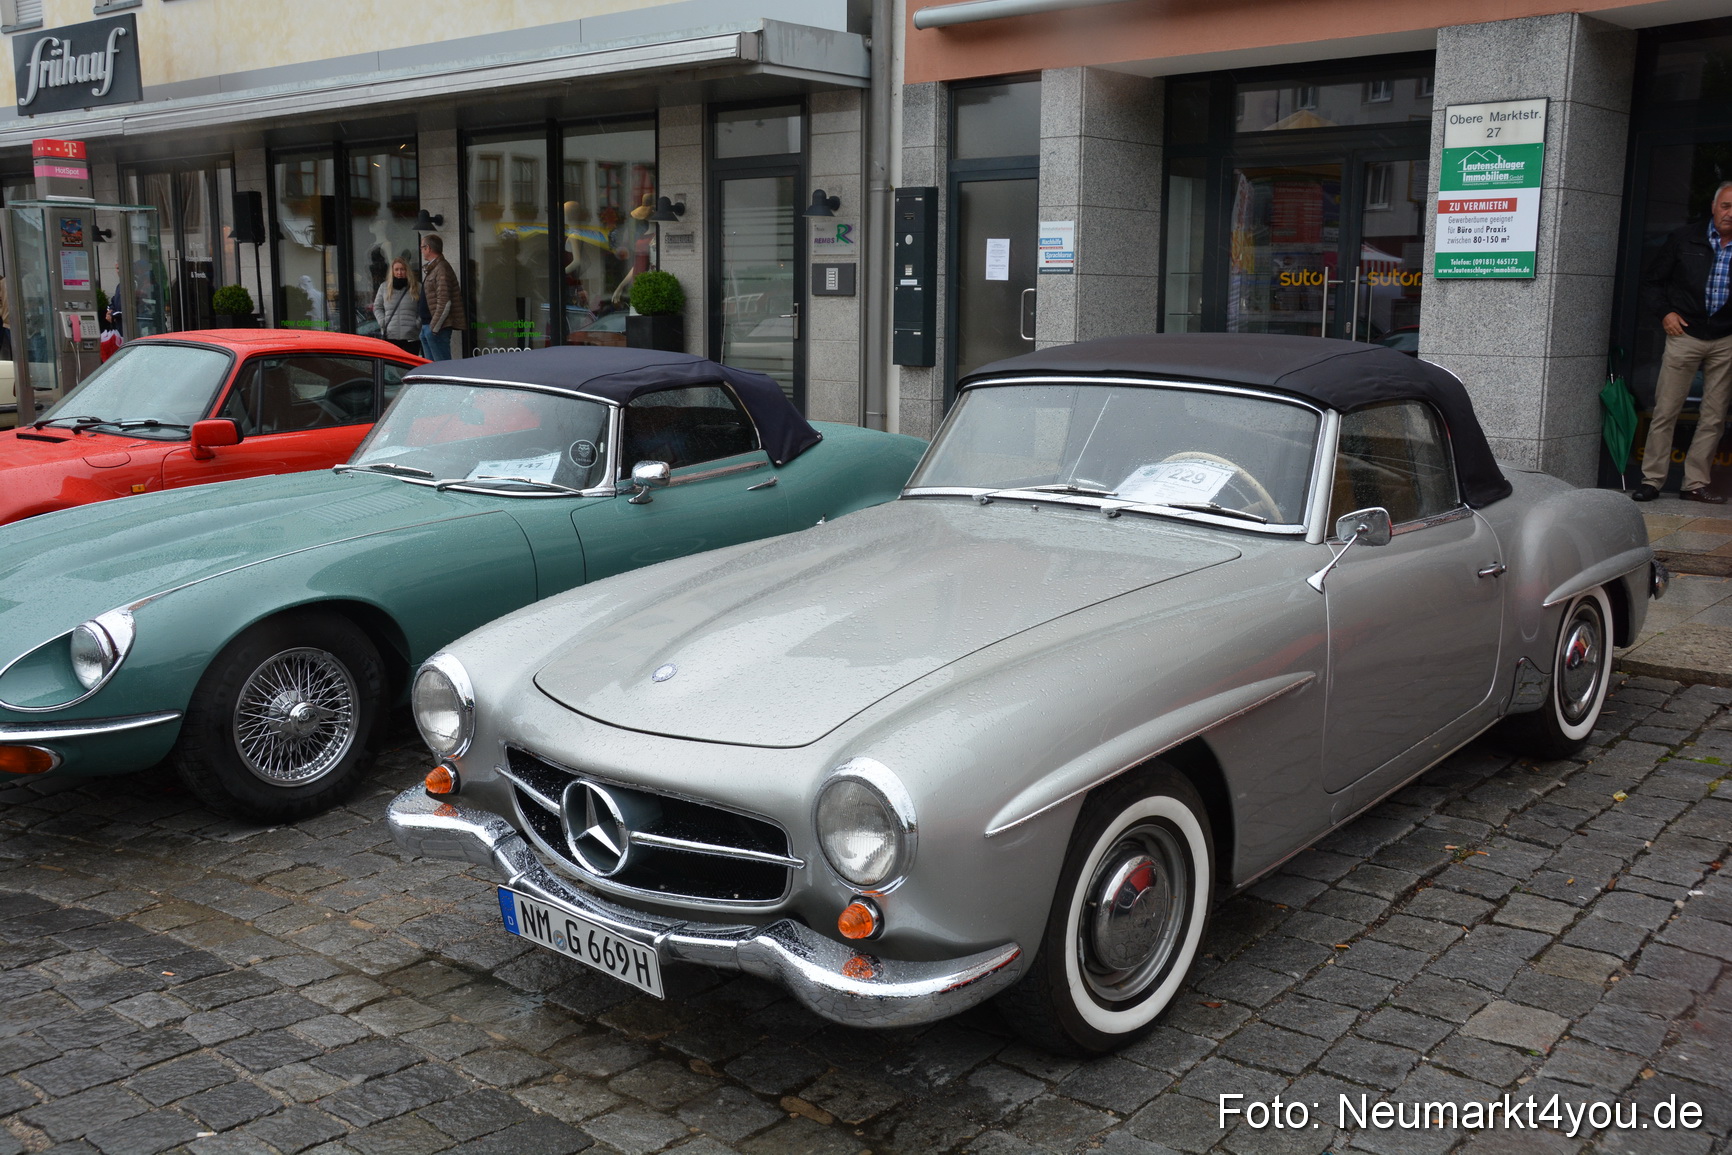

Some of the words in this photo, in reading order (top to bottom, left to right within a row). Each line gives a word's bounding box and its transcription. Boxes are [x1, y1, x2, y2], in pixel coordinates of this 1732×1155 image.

[18, 27, 126, 106] frühauf
[1450, 114, 1483, 125] Obere
[1489, 109, 1542, 122] Marktstr.
[1486, 127, 1502, 138] 27
[1462, 155, 1525, 171] Lautenschlager
[55, 166, 80, 175] HotSpot
[1462, 171, 1509, 182] Immobilien
[1449, 203, 1460, 211] ZU
[1463, 201, 1509, 211] VERMIETEN
[1448, 215, 1488, 224] Gewerberäume
[1489, 215, 1514, 225] geeignet
[1447, 226, 1456, 234] für
[1456, 226, 1472, 234] Büro
[1485, 225, 1507, 233] Praxis
[1447, 236, 1472, 244] zwischen
[1473, 235, 1499, 243] 80-150
[1500, 235, 1511, 243] m²
[1472, 258, 1496, 266] (09181)
[1438, 265, 1530, 275] www.lautenschlager-immobilien.de
[1167, 468, 1207, 485] 229
[507, 915, 514, 926] D
[520, 900, 552, 944] NM
[565, 919, 582, 956] G
[587, 929, 652, 988] 669H
